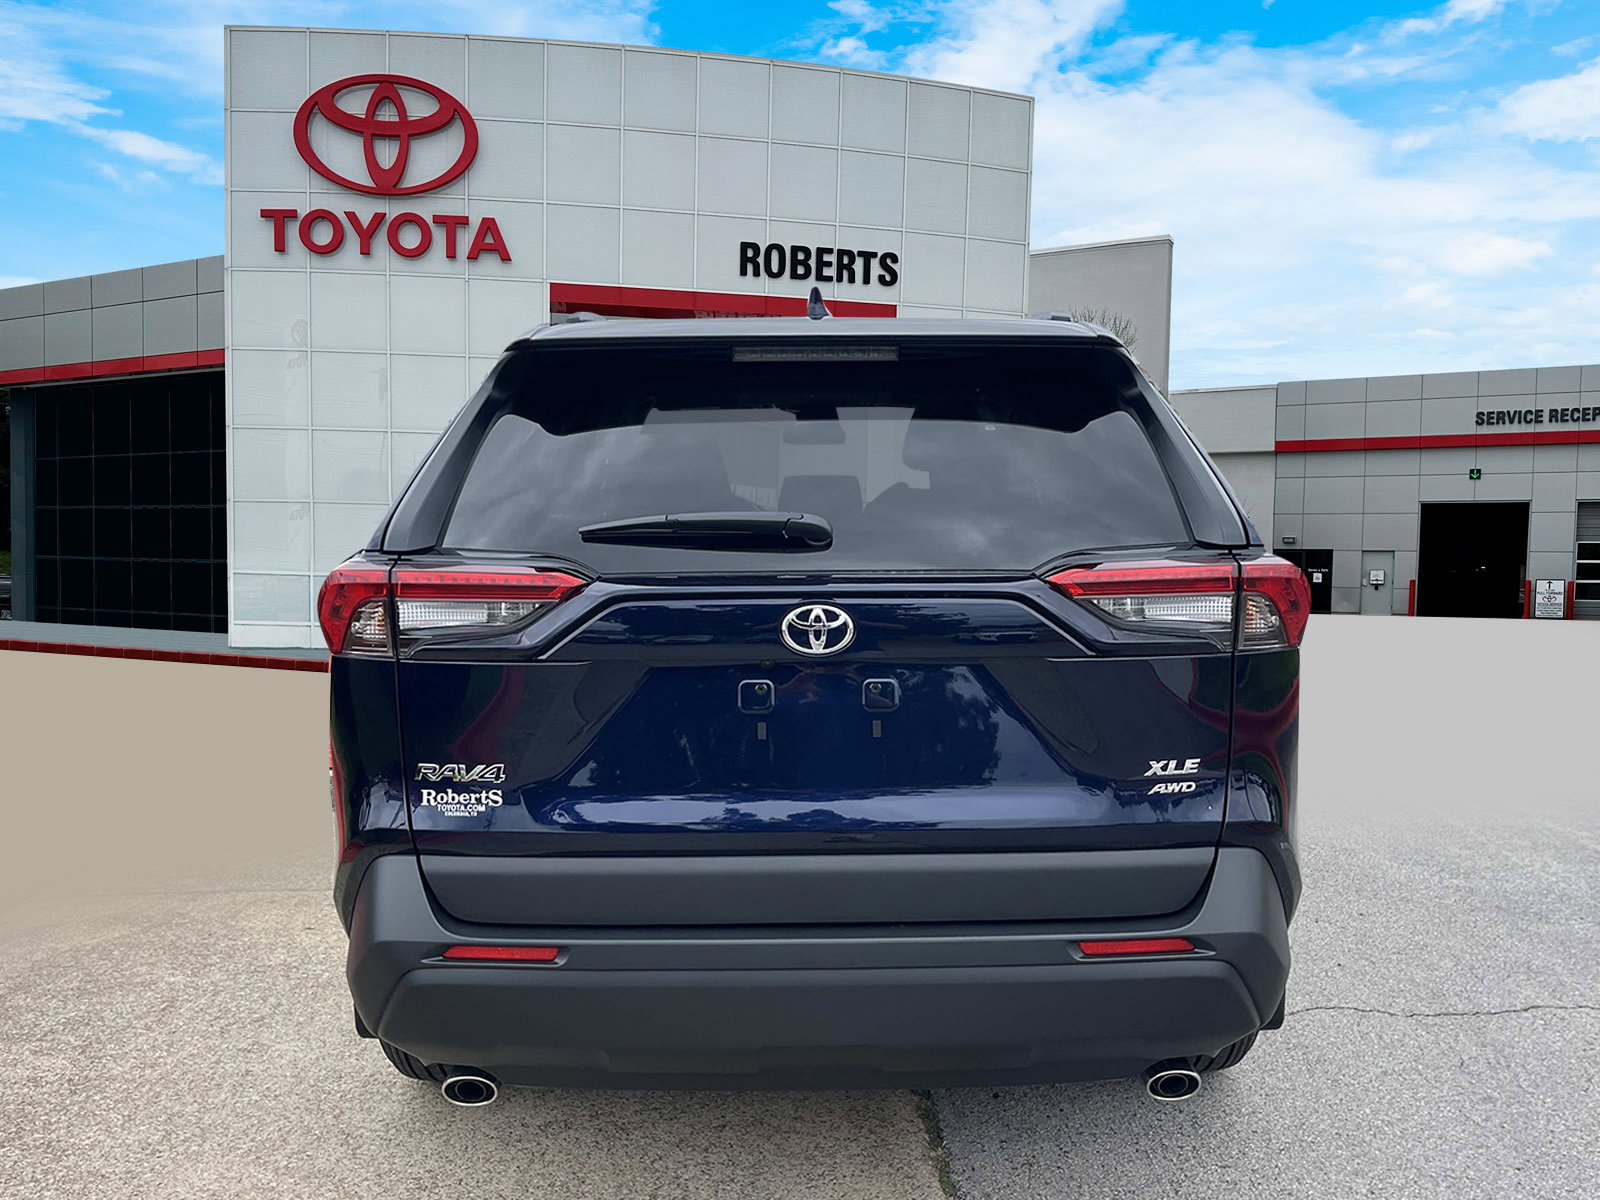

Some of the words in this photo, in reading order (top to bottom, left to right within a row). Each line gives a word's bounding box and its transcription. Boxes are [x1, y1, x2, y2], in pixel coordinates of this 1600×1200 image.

[260, 208, 512, 261] TOYOTA
[740, 241, 899, 287] ROBERTS
[1475, 409, 1544, 426] SERVICE
[415, 763, 506, 783] RAV4
[1144, 758, 1201, 776] XLE
[1147, 781, 1196, 795] AWD
